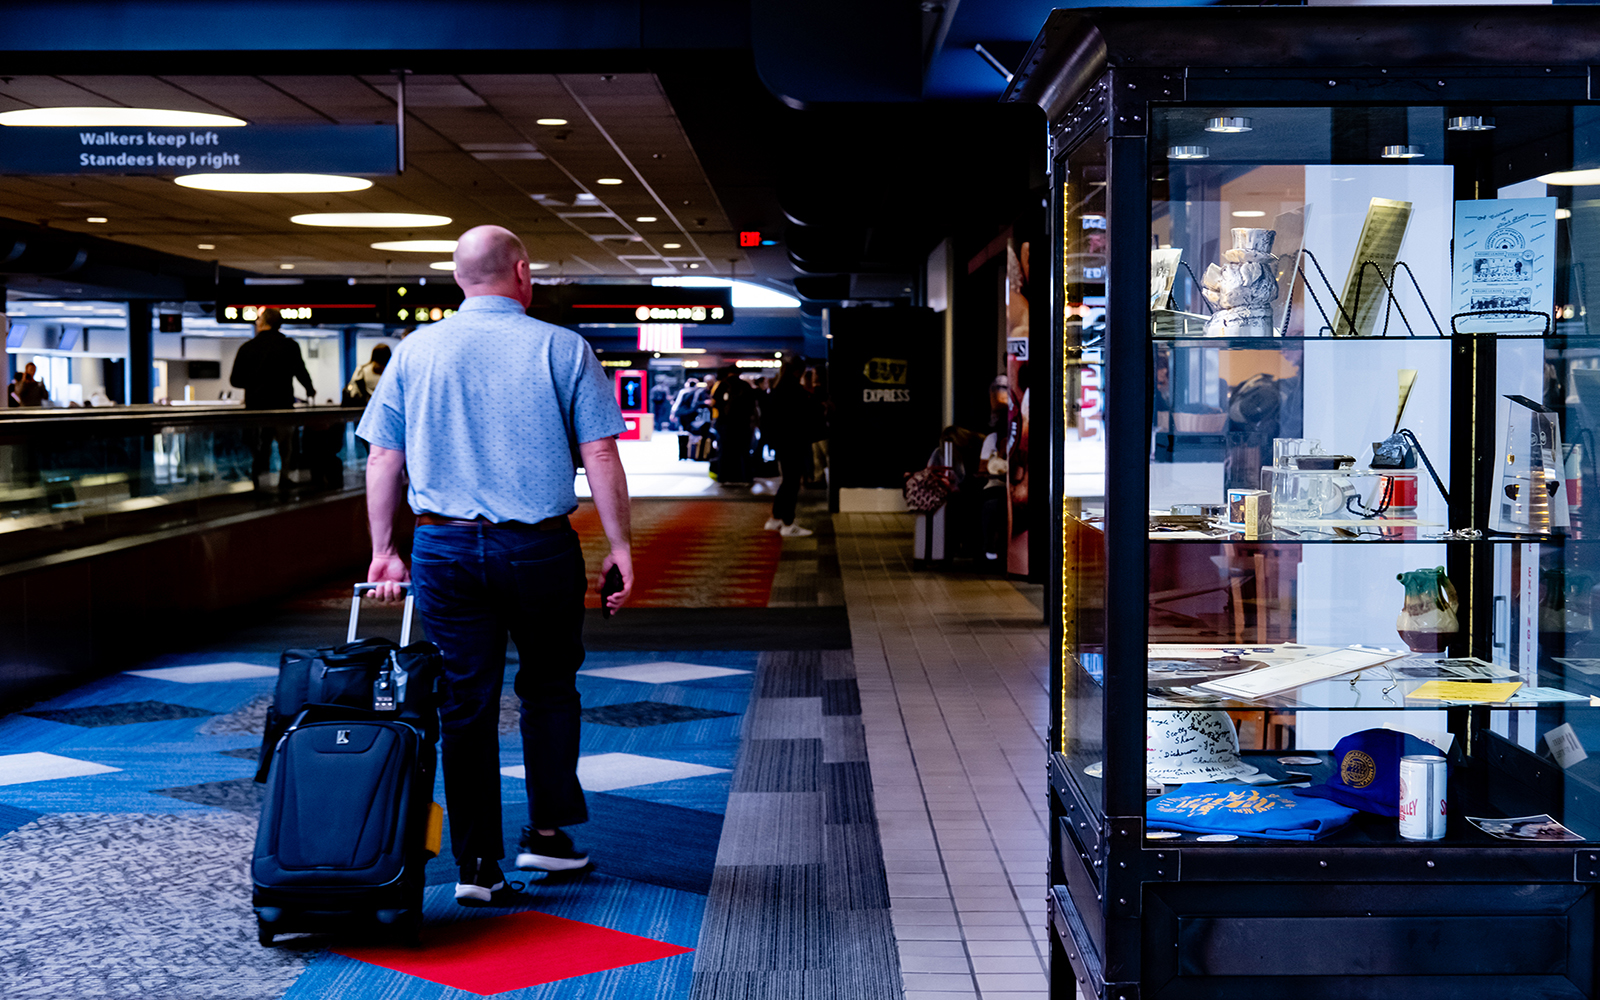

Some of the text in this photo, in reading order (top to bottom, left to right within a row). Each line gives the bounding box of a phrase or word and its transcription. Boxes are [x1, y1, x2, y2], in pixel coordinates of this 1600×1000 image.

[79, 132, 219, 148] Walkers keep left
[79, 152, 241, 169] Standees keep right
[863, 389, 910, 402] EXPRESS
